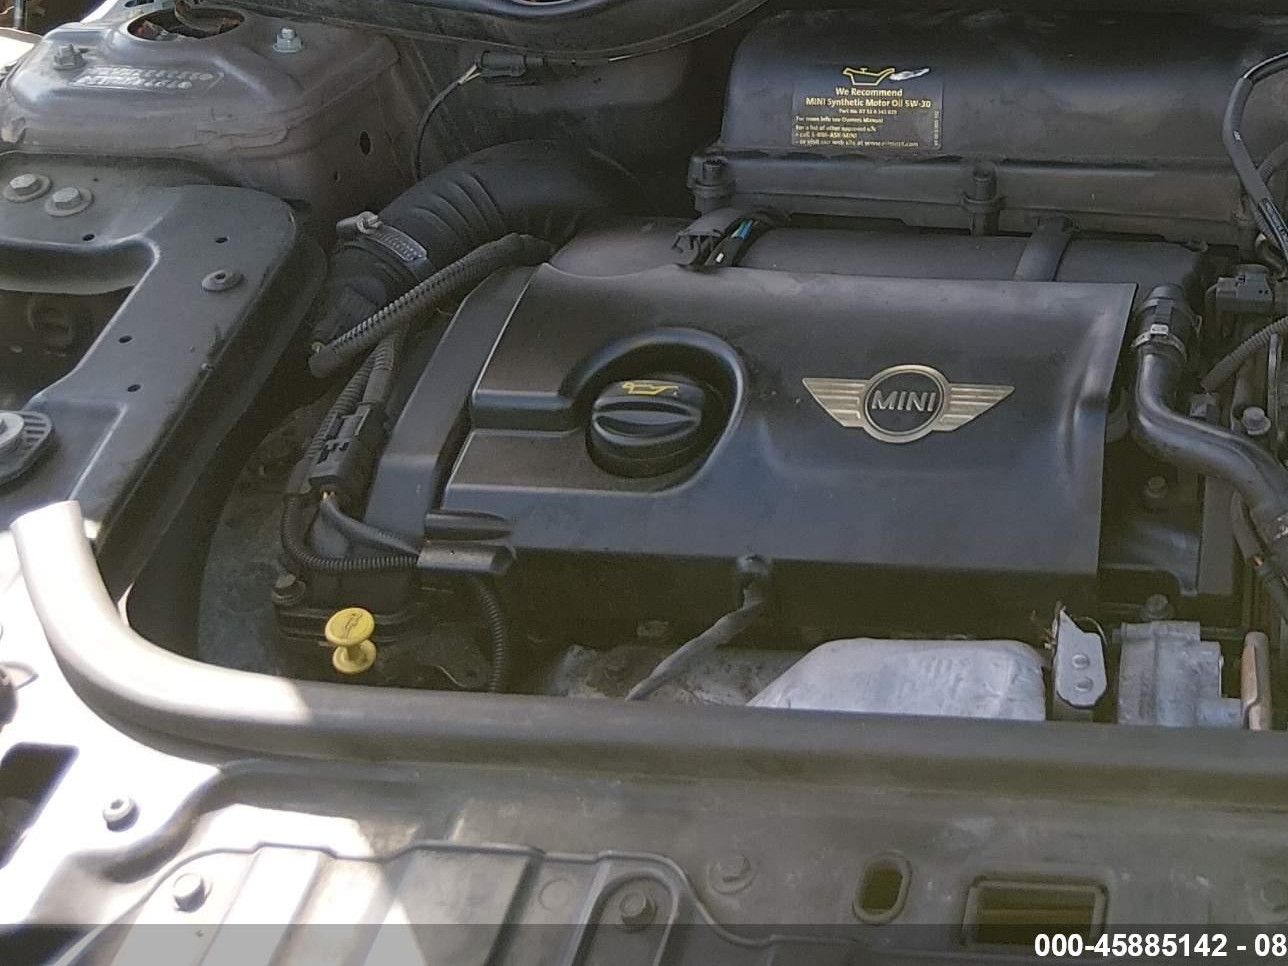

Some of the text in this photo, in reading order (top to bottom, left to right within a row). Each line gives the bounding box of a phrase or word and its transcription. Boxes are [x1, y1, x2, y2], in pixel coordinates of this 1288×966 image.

[835, 87, 903, 97] We Recommend
[805, 97, 932, 108] MINI Synthetic Motor Oil 5W-30
[871, 390, 936, 412] MINI
